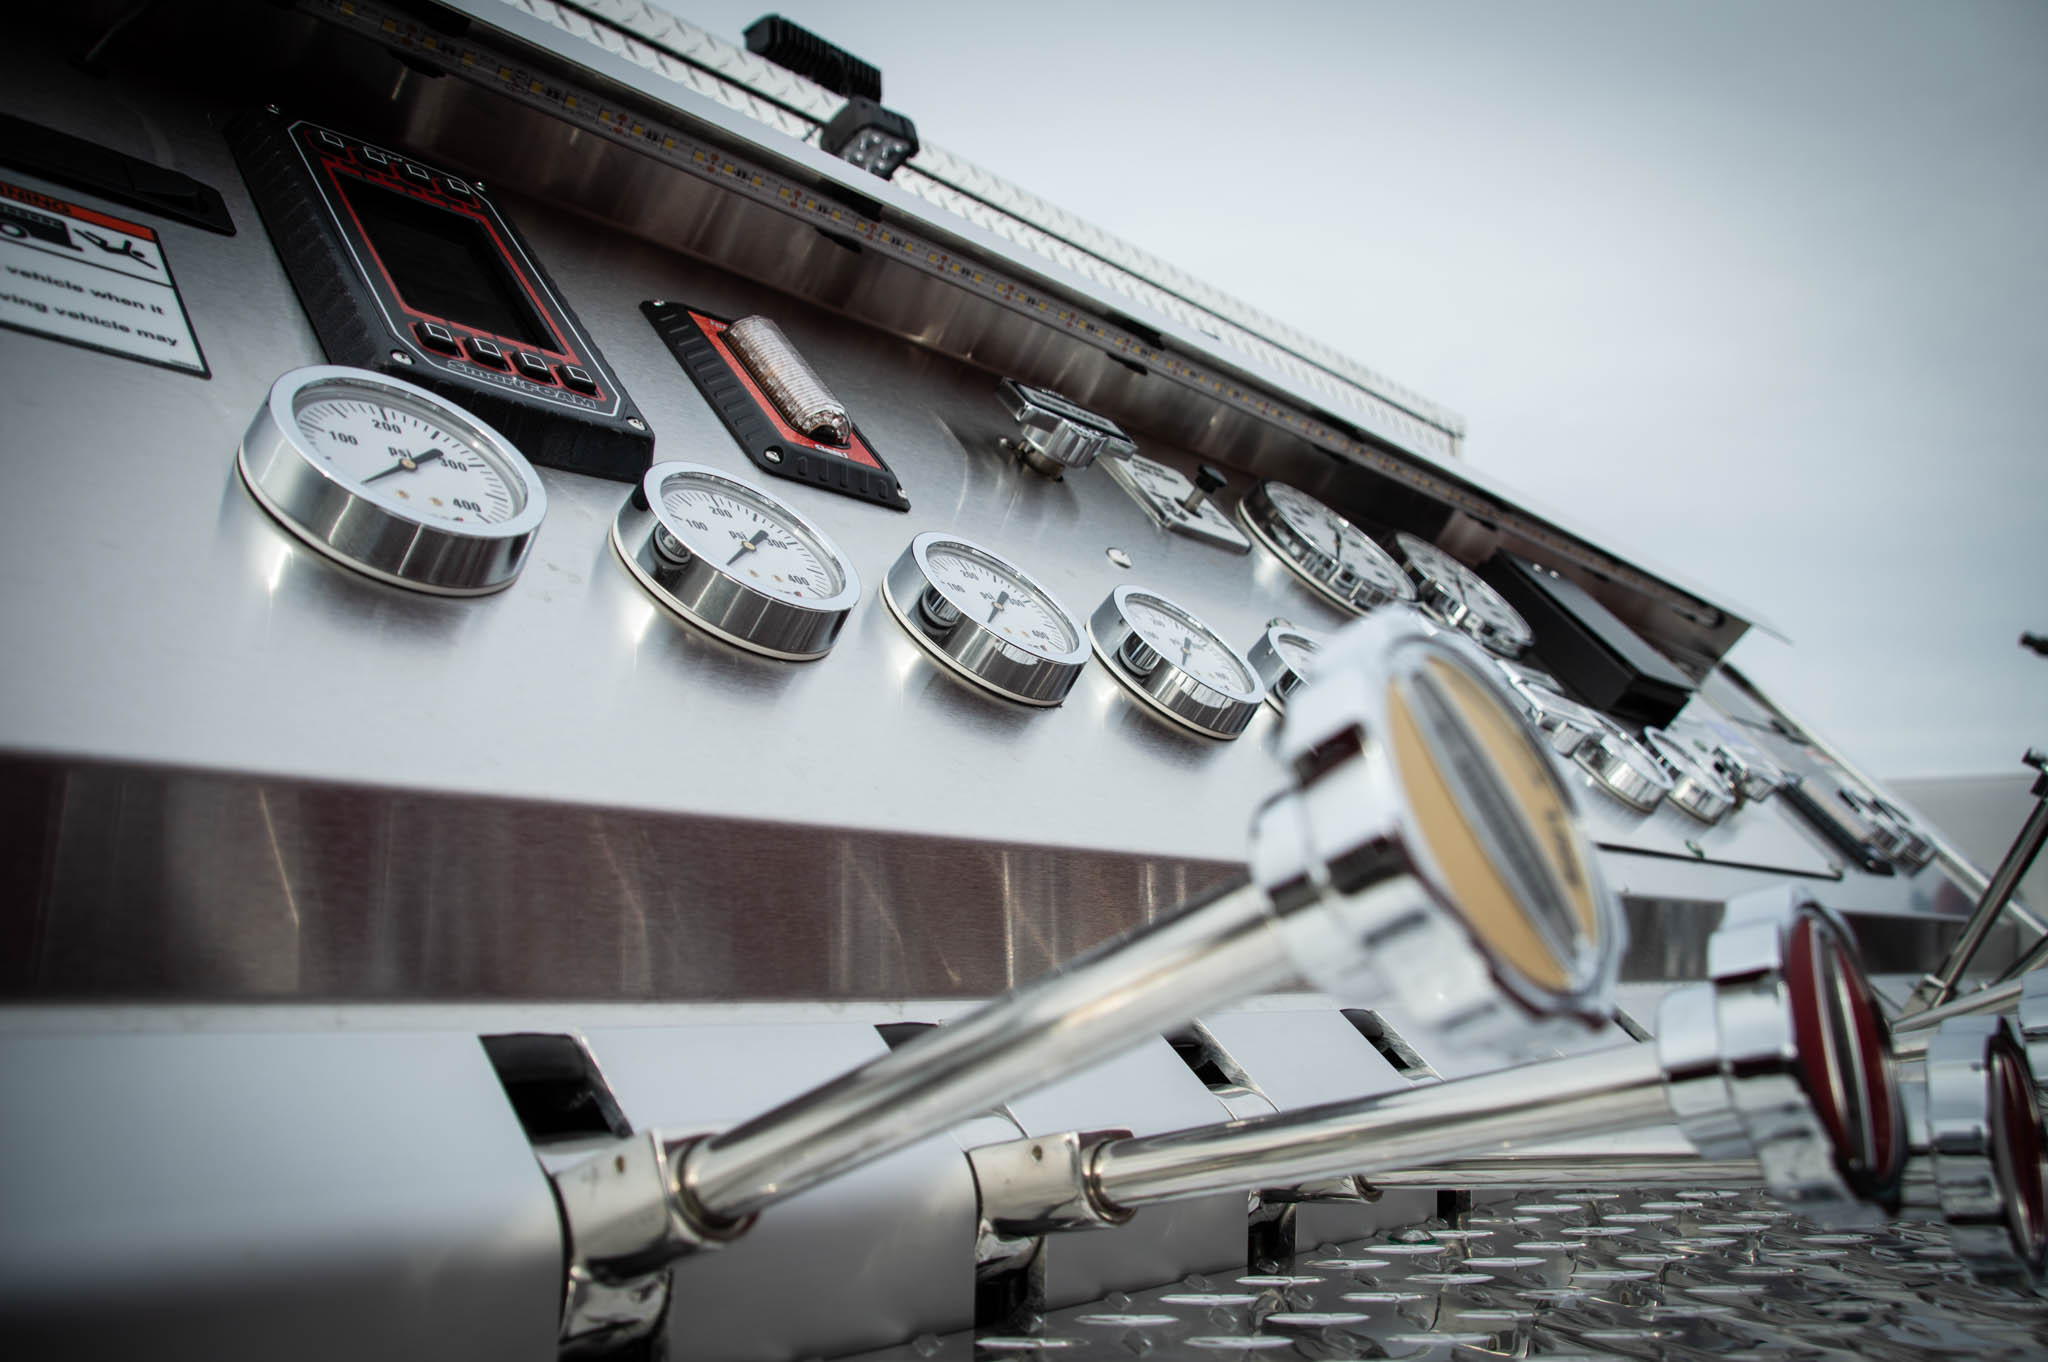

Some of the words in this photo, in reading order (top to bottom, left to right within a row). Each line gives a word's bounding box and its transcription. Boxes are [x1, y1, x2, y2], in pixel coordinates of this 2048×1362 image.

[5, 264, 84, 294] vehicle
[90, 288, 145, 311] when
[150, 303, 165, 316] it
[54, 306, 131, 333] vehicle
[136, 328, 178, 347] may
[371, 418, 402, 435] 200
[328, 430, 358, 446] 100
[388, 446, 413, 461] psi
[440, 456, 467, 473] 300
[452, 498, 482, 513] 400
[710, 505, 732, 518] 200
[686, 518, 708, 532] 100
[729, 531, 747, 543] psi
[767, 538, 788, 551] 300
[788, 573, 810, 587] 400
